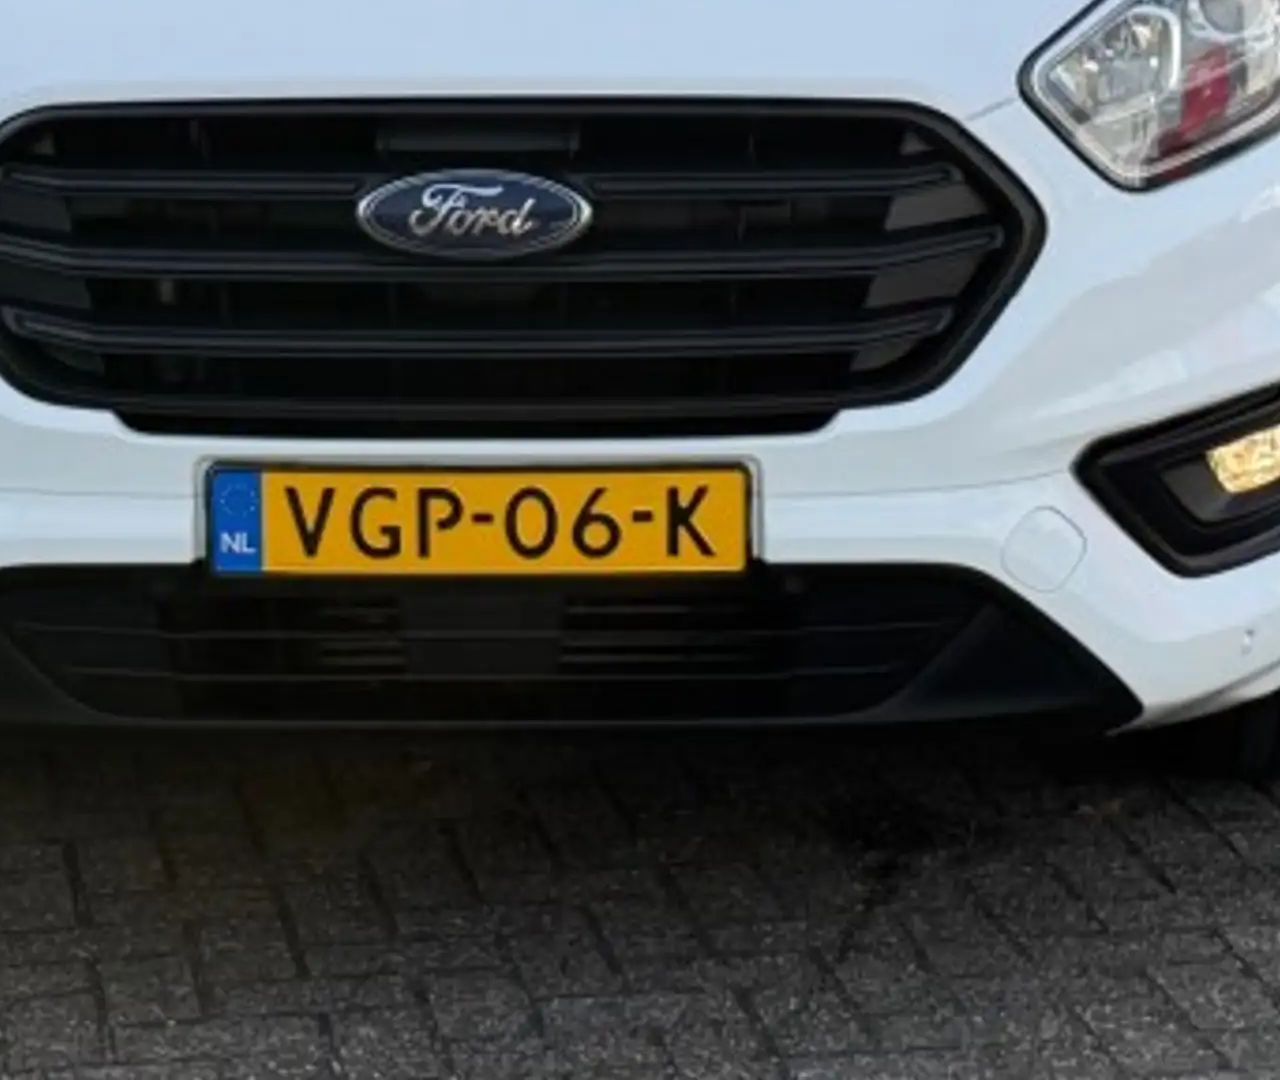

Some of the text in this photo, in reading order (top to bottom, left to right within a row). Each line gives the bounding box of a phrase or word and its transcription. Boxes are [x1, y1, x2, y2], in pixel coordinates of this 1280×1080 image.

[408, 183, 536, 237] Ford
[220, 532, 256, 554] NL
[284, 485, 717, 559] VGP-06-K
